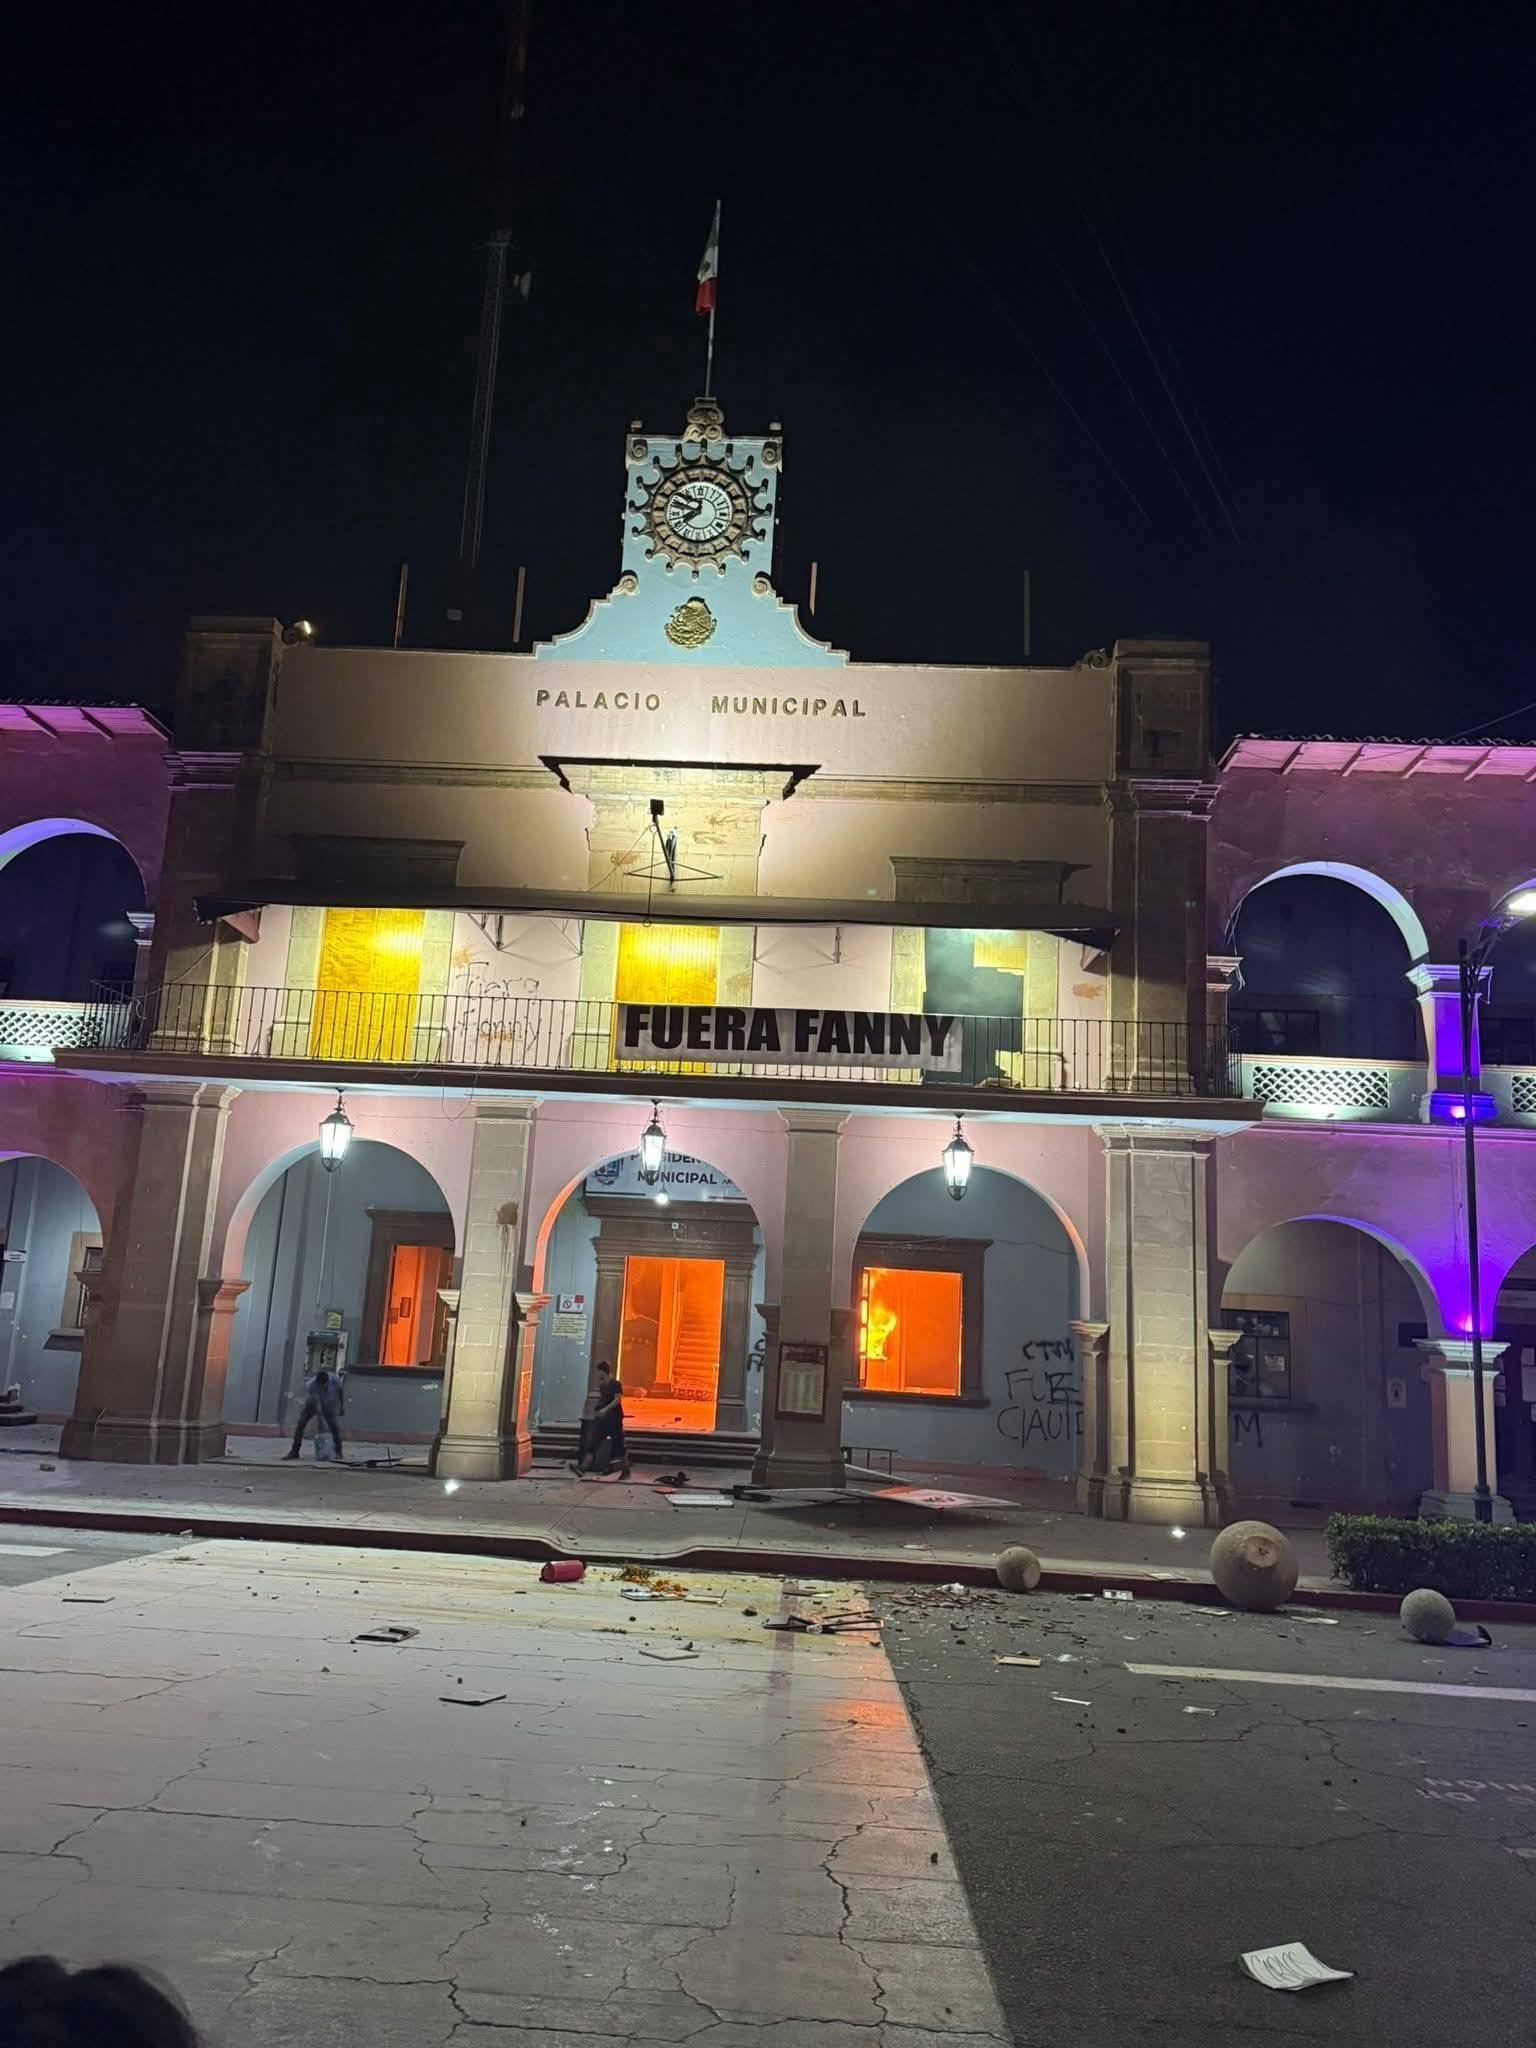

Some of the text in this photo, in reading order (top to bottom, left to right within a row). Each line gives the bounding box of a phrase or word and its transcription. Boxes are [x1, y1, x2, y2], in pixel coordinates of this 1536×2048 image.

[536, 689, 866, 717] PALACIO MUNICIPAL
[624, 1003, 955, 1057] FUERA FANNY
